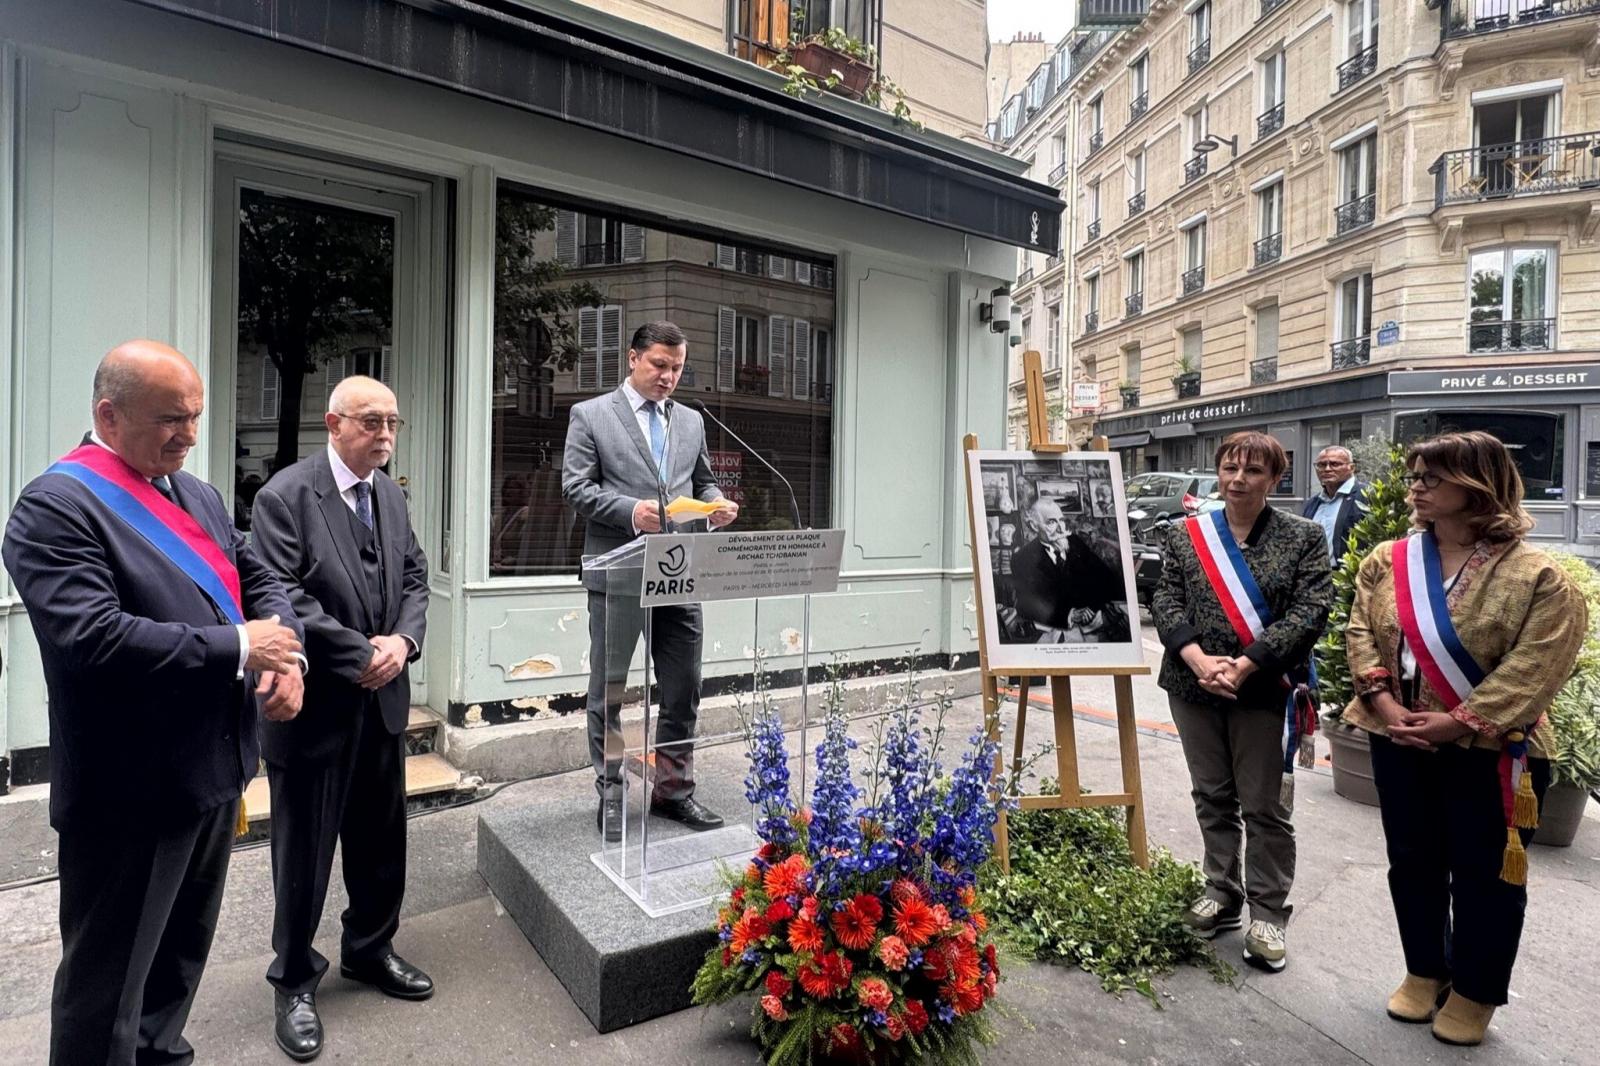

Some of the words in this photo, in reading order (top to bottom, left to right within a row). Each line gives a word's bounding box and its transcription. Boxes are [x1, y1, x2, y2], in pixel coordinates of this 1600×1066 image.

[1441, 374, 1486, 388] PRIVÉ
[1492, 376, 1508, 386] de
[1513, 372, 1588, 386] DESSERT
[1161, 412, 1187, 426] privé
[1189, 408, 1201, 419] de
[728, 535, 775, 543] DÉVOILEMENT
[795, 533, 821, 541] PLAQUE
[717, 544, 776, 553] COMMÉMORATIVE
[765, 551, 808, 559] TCHOBANIAN
[645, 578, 694, 596] PARIS
